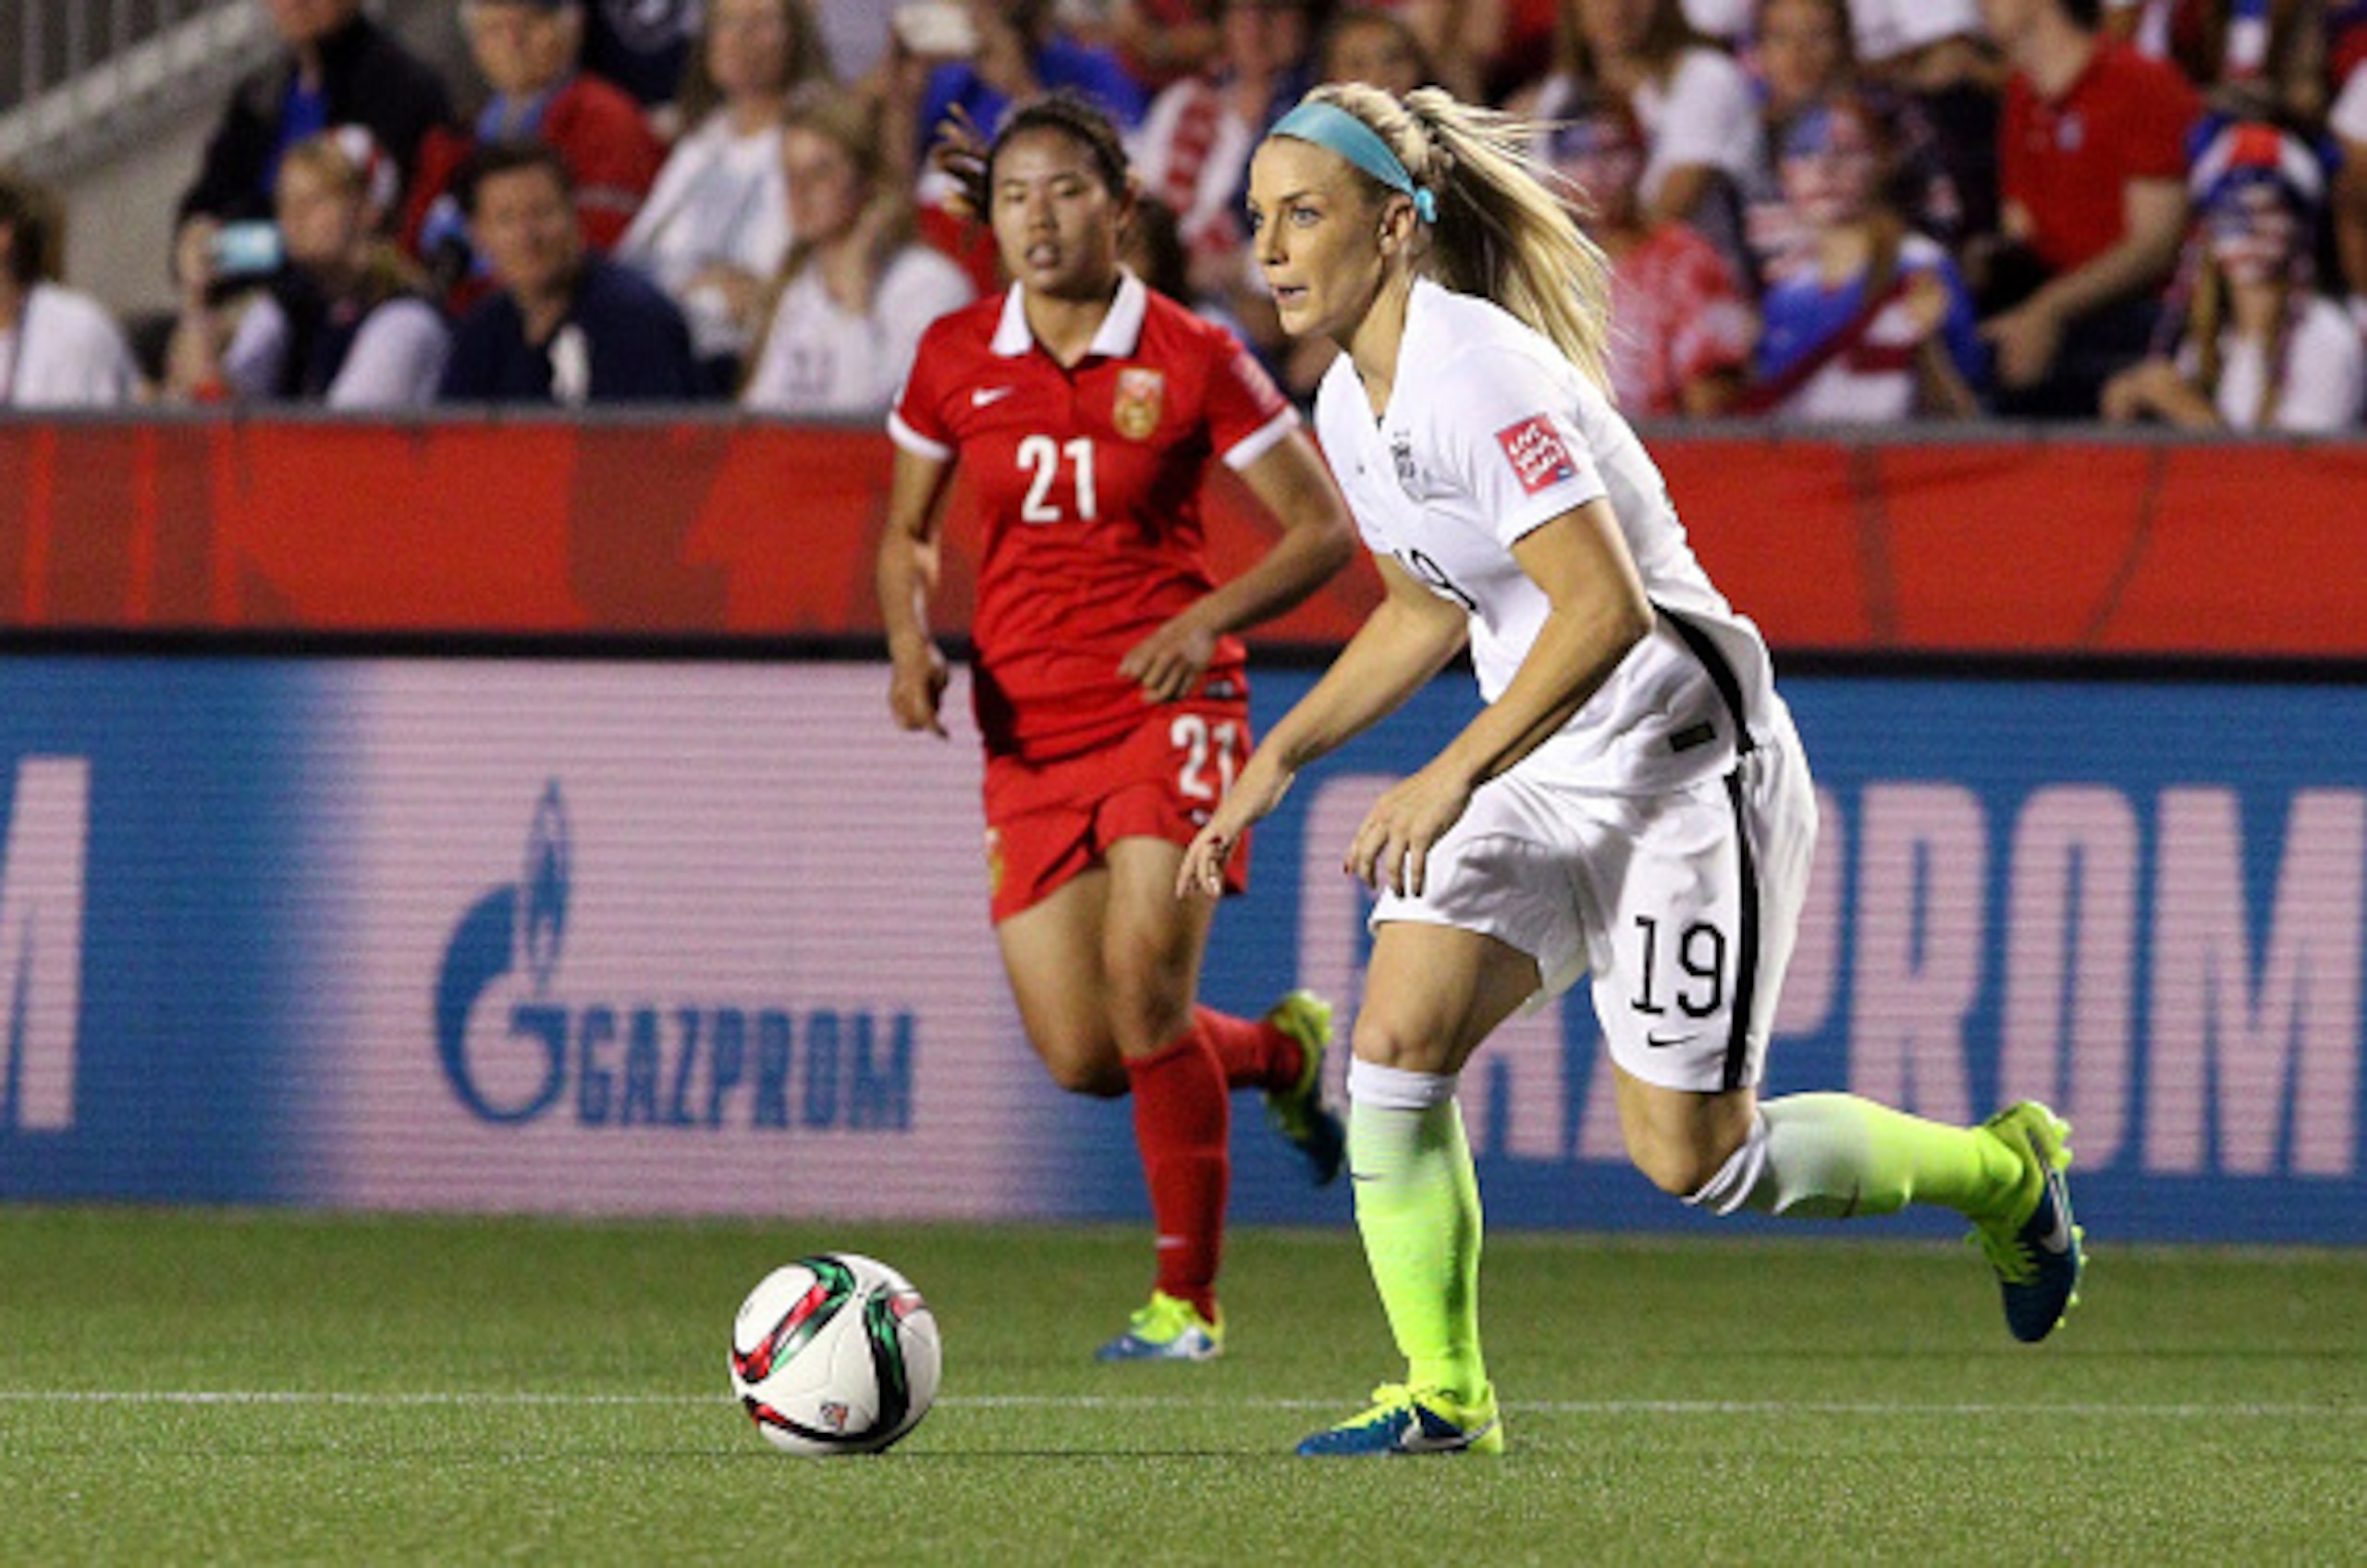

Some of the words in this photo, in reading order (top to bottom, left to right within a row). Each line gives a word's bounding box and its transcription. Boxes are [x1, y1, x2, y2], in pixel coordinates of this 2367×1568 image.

[1016, 435, 1097, 523] 21
[1393, 548, 1478, 612] 9
[1171, 714, 1236, 801] 21
[1631, 914, 1725, 1018] 19
[575, 1003, 916, 1133] GAZPROM
